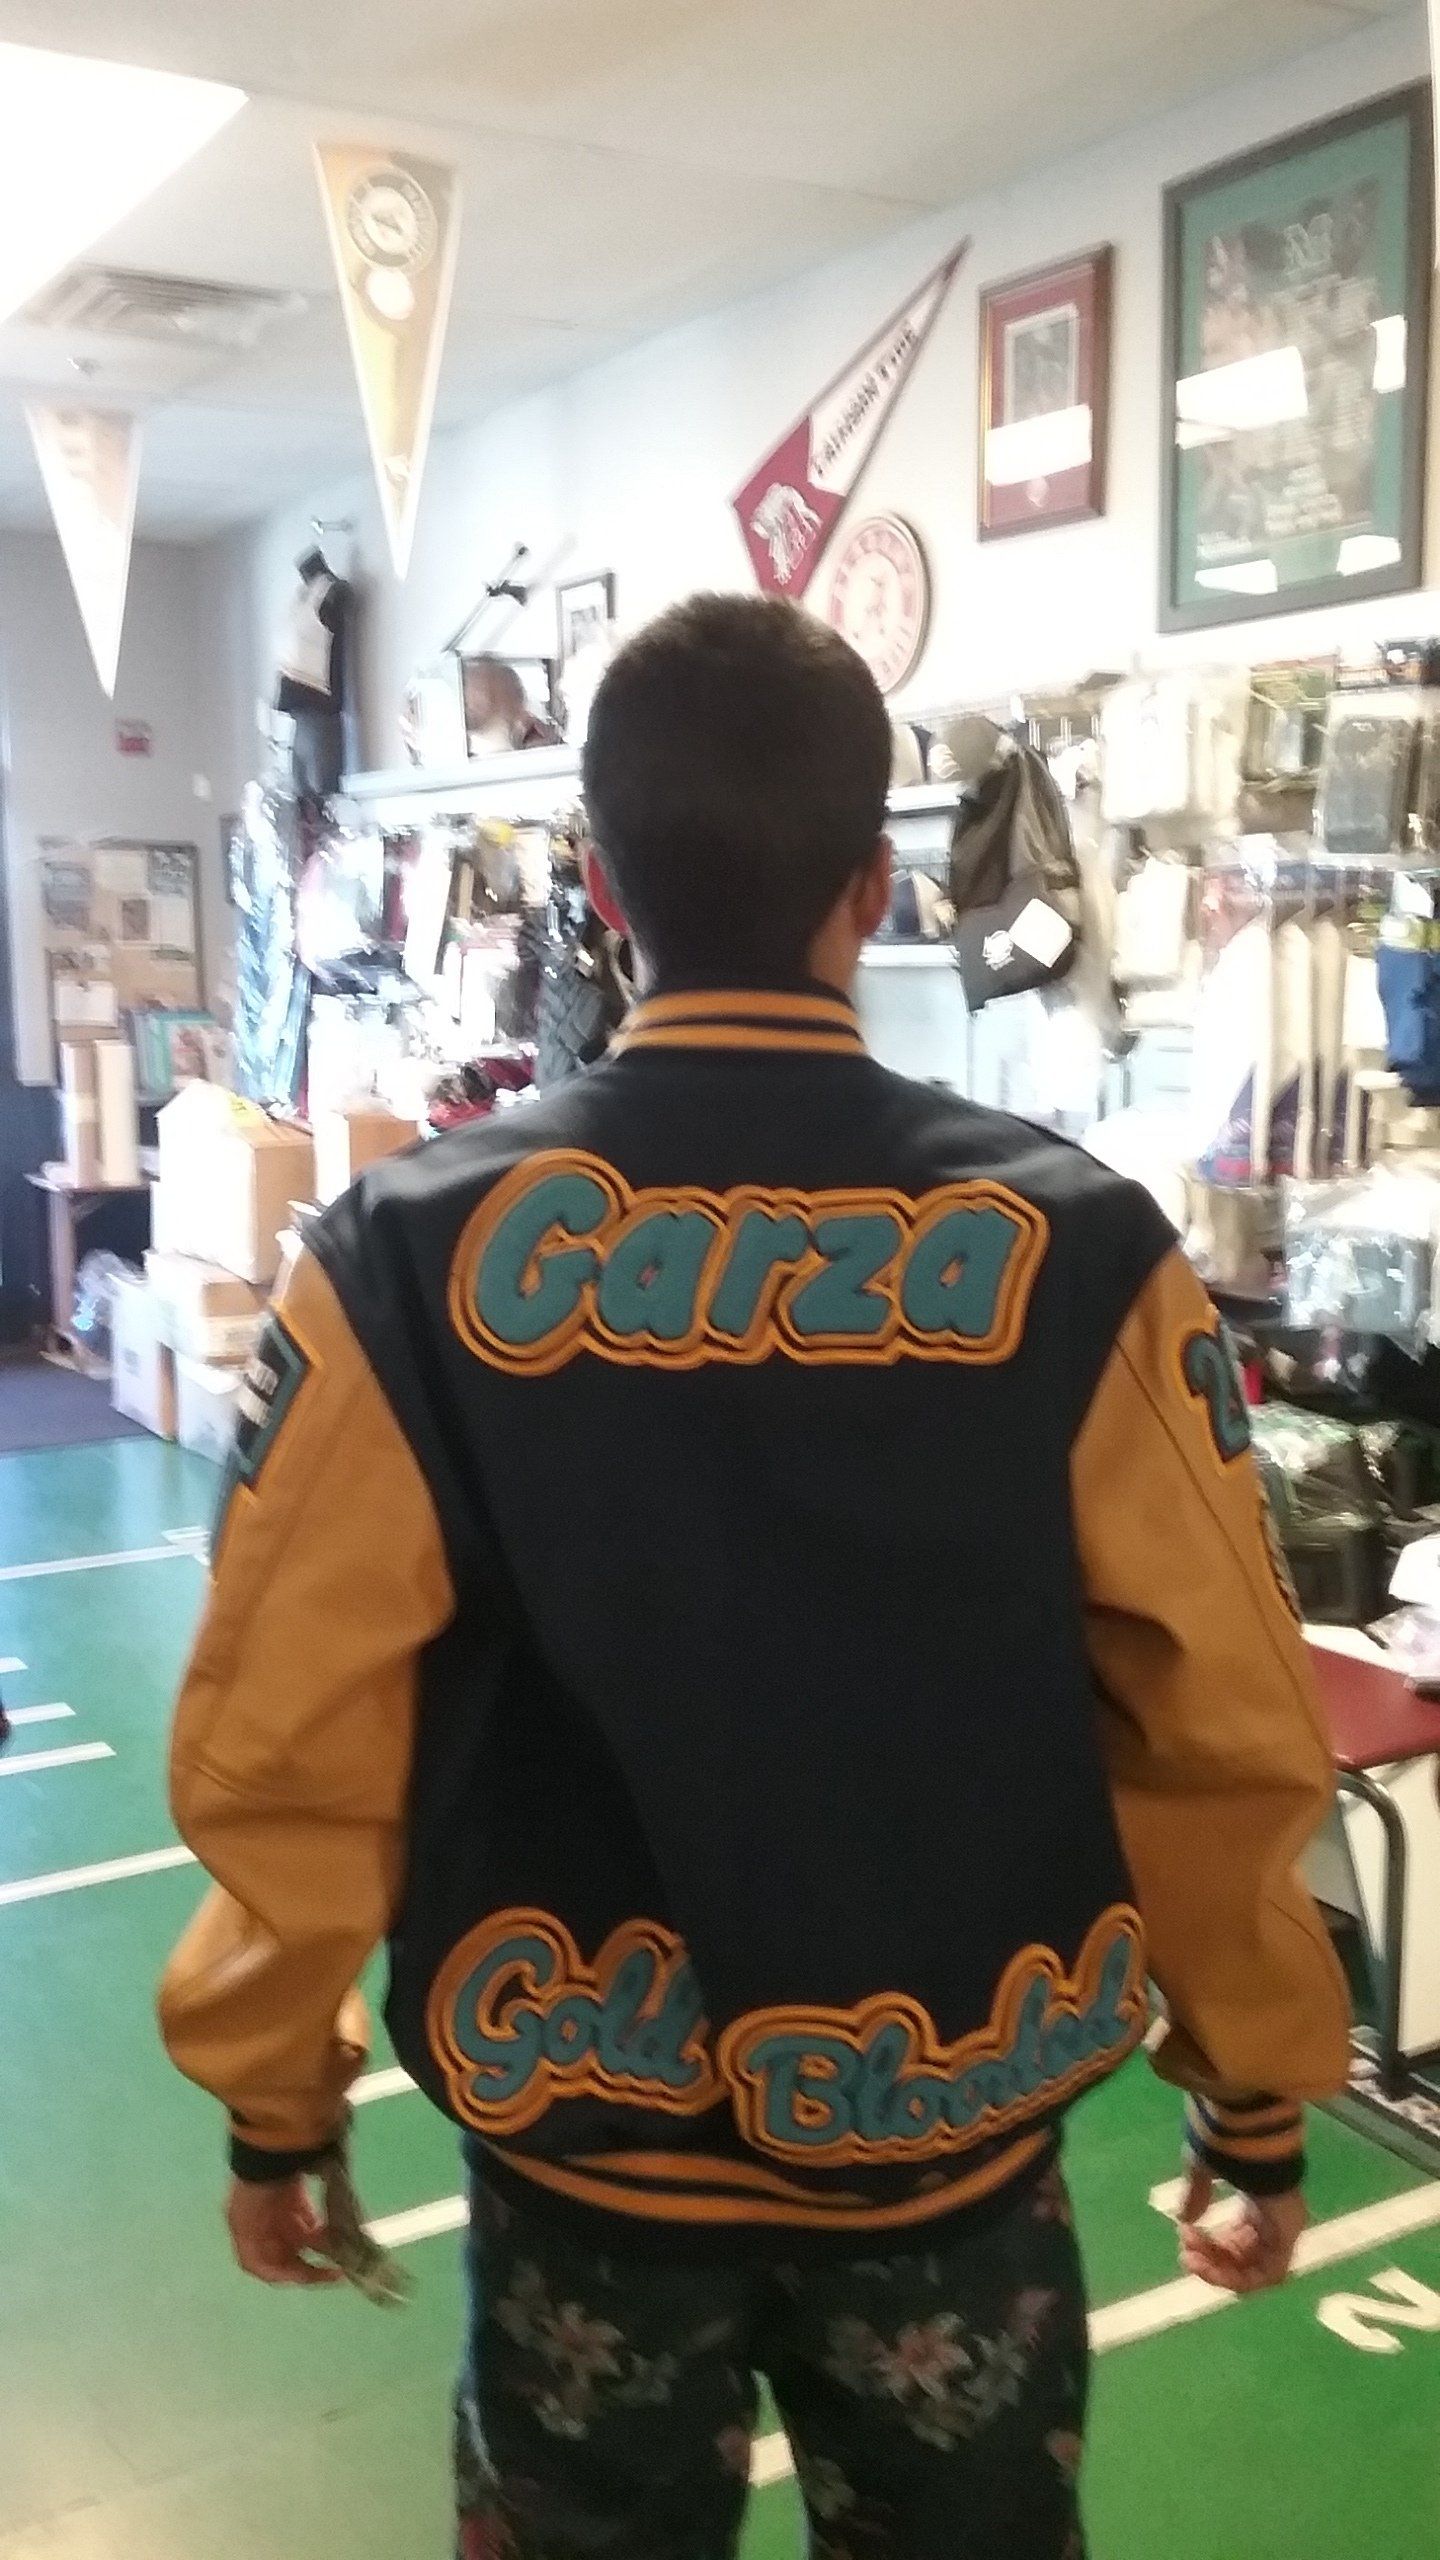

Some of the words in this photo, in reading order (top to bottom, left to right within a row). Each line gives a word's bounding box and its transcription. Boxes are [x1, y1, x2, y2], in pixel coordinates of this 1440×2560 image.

[465, 1160, 1032, 1360] Garza
[445, 1926, 708, 2113] Gold
[737, 1926, 1135, 2153] Blooded
